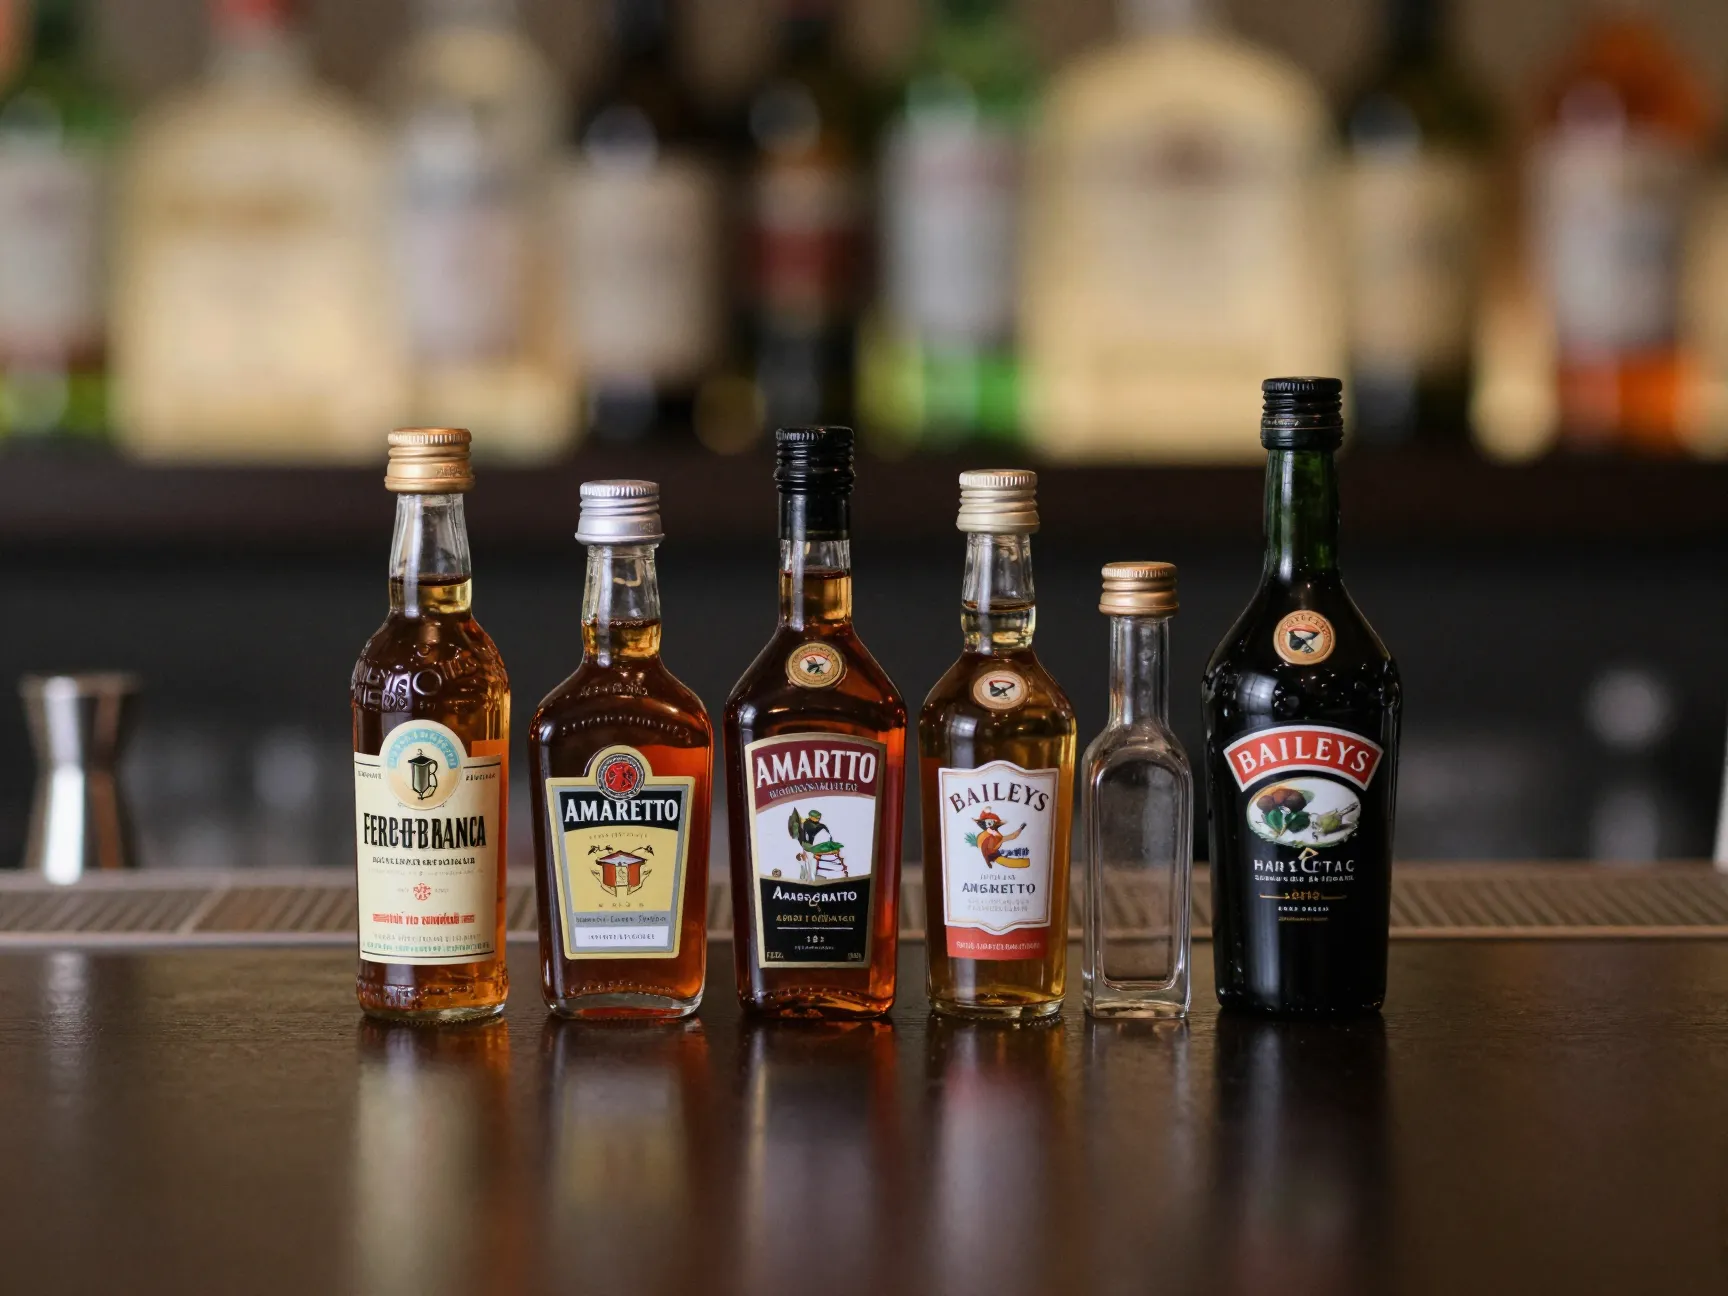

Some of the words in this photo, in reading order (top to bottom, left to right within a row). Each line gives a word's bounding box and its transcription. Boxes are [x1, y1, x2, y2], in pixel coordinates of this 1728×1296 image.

[756, 749, 877, 789] AMARTTO
[1236, 736, 1370, 775] BAILEYS
[564, 798, 679, 822] AMARETTO
[948, 781, 1050, 814] BAILEYS
